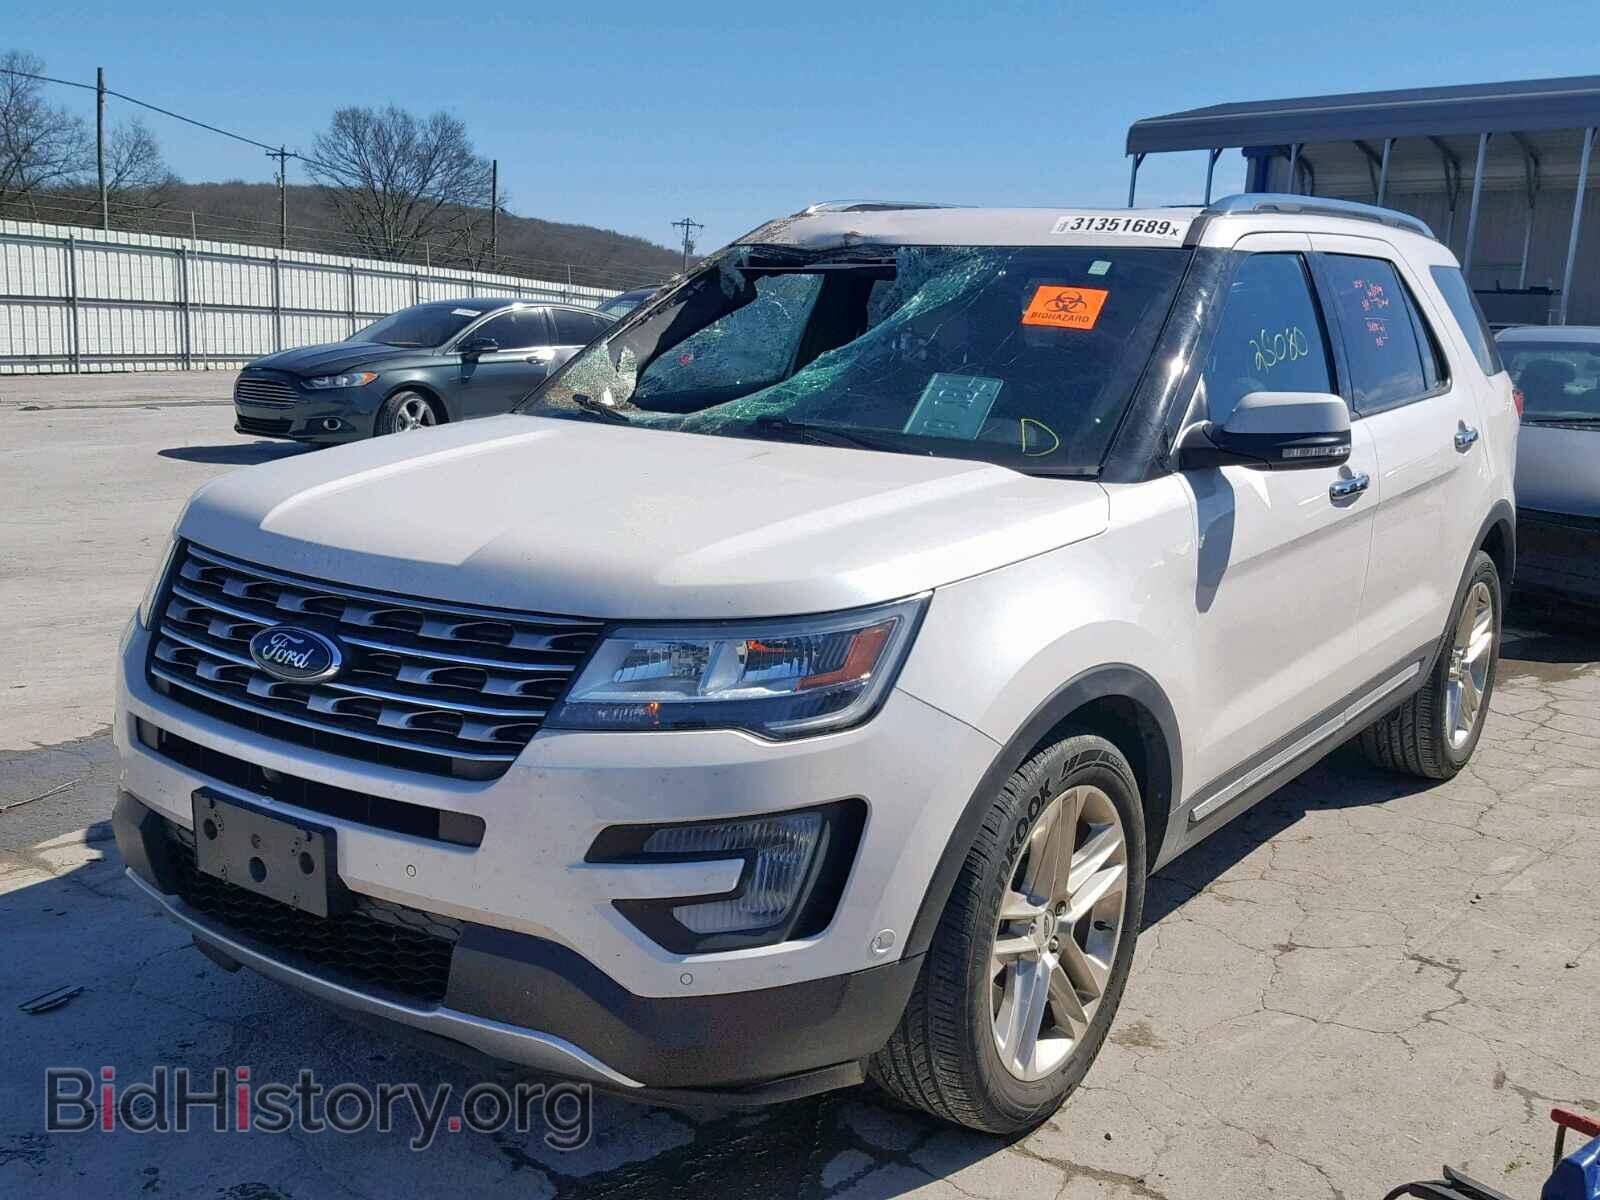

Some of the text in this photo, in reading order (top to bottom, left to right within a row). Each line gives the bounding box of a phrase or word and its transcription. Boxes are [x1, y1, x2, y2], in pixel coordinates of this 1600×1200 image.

[1031, 311, 1090, 323] BIOHAZARD
[1020, 418, 1060, 457] D
[262, 633, 315, 669] Ford
